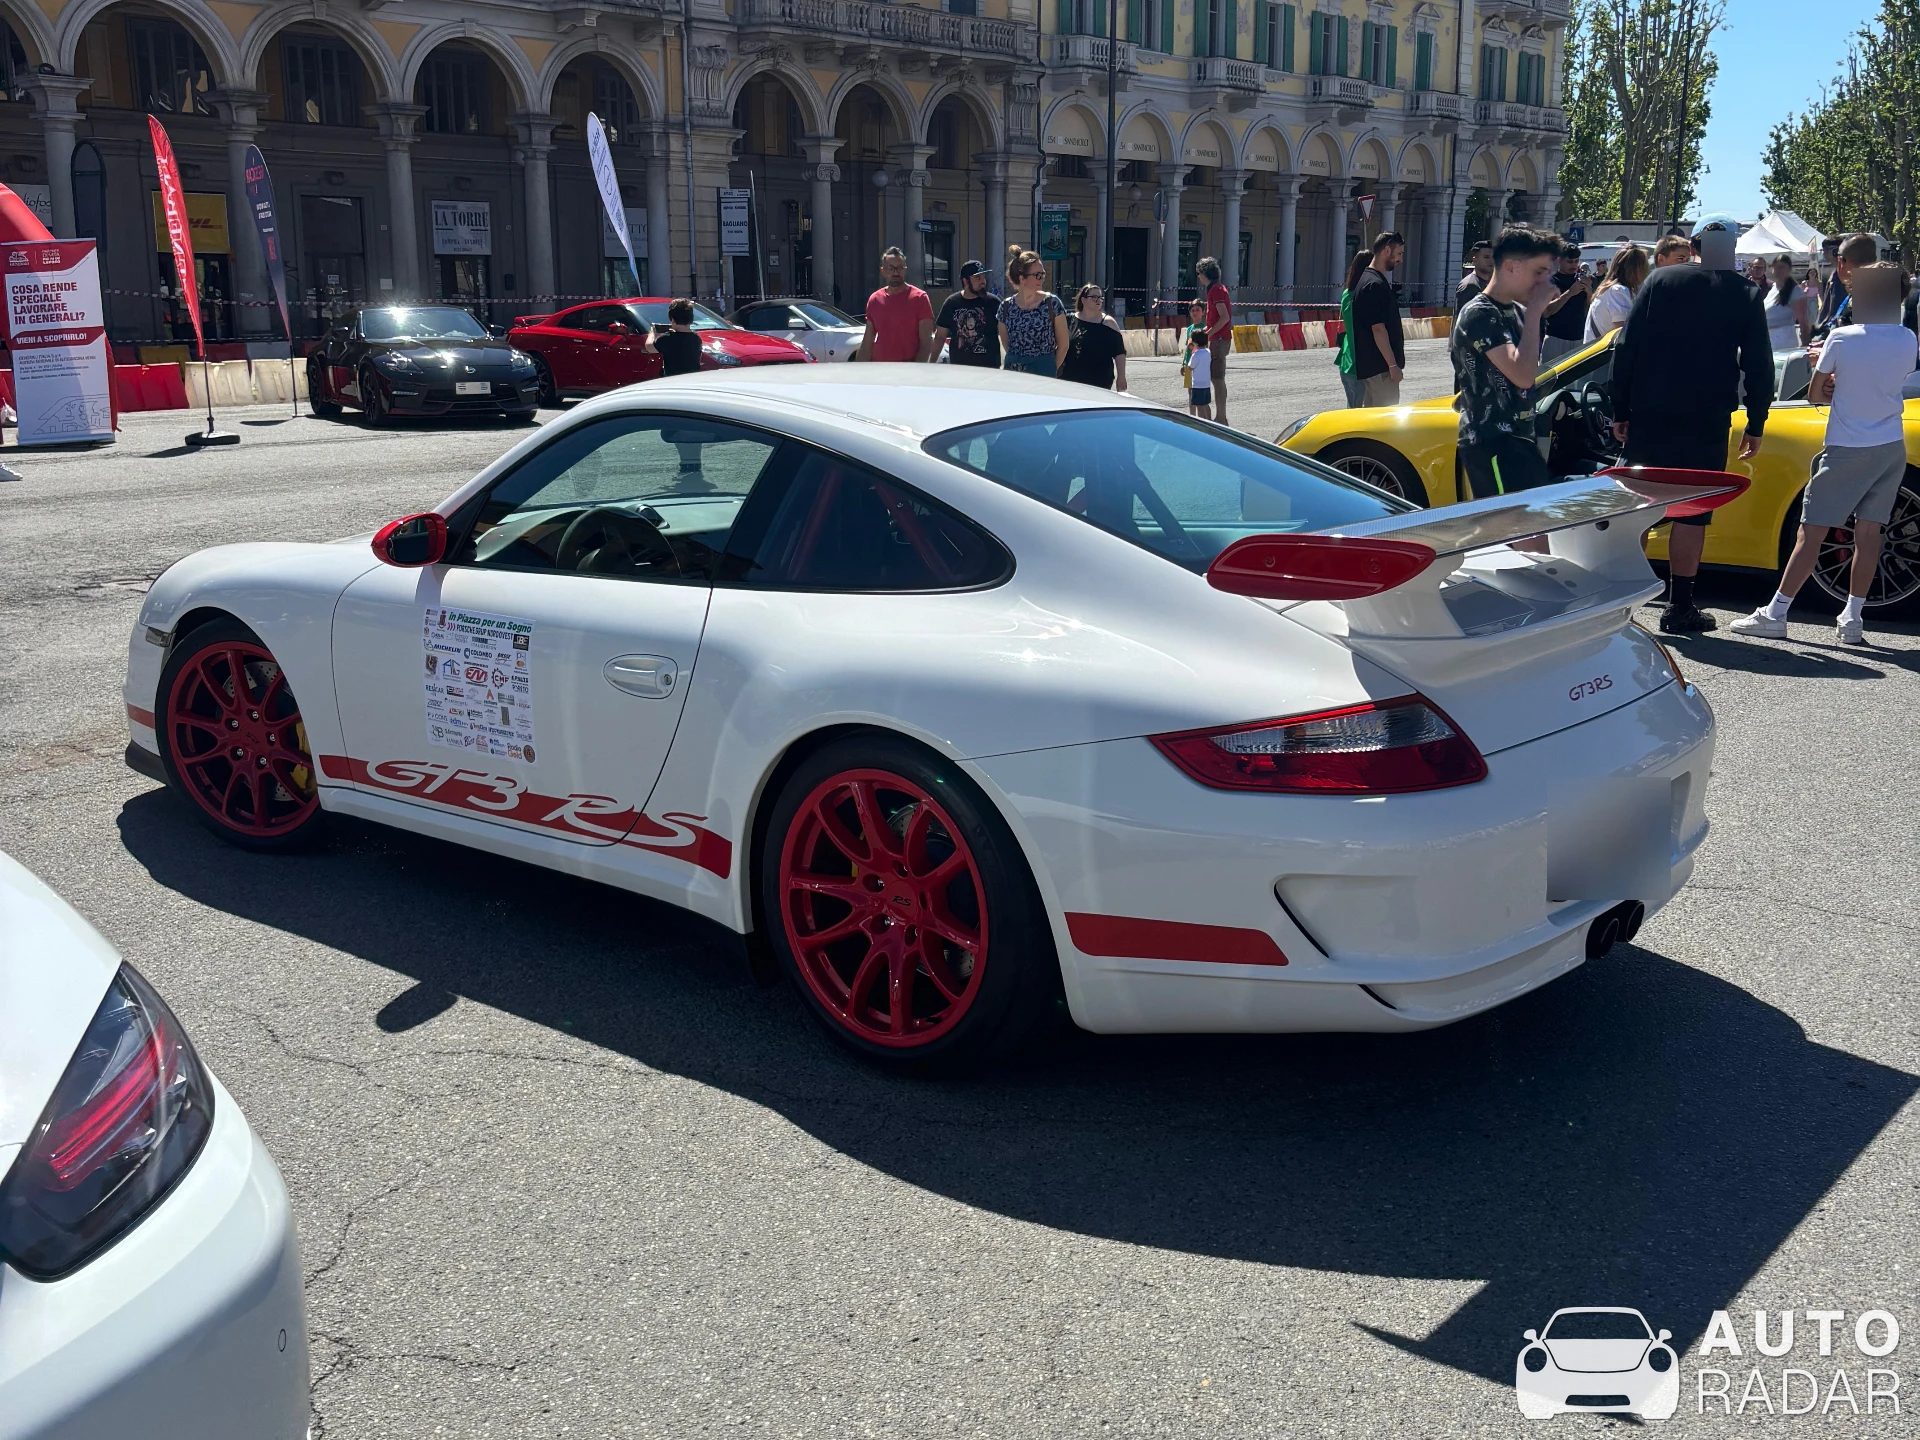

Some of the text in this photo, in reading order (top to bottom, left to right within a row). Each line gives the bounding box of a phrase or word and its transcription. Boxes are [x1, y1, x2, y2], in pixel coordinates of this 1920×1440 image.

[434, 211, 489, 227] LA TORRE
[12, 282, 78, 295] COSA RENDE
[13, 293, 62, 305] SPECIALE
[14, 302, 68, 315] LAVORARE
[15, 311, 86, 325] IN GENERALI?
[16, 337, 36, 345] VIENI
[44, 333, 87, 343] SCOPRIRLO!
[448, 611, 457, 621] in
[457, 612, 481, 625] Piazza
[480, 619, 496, 629] per
[495, 620, 506, 628] un
[506, 621, 532, 634] Sogno
[433, 643, 461, 654] MICHELIN
[470, 649, 493, 659] COLOMBO
[367, 760, 709, 848] GT3 RS
[892, 895, 912, 907] RS
